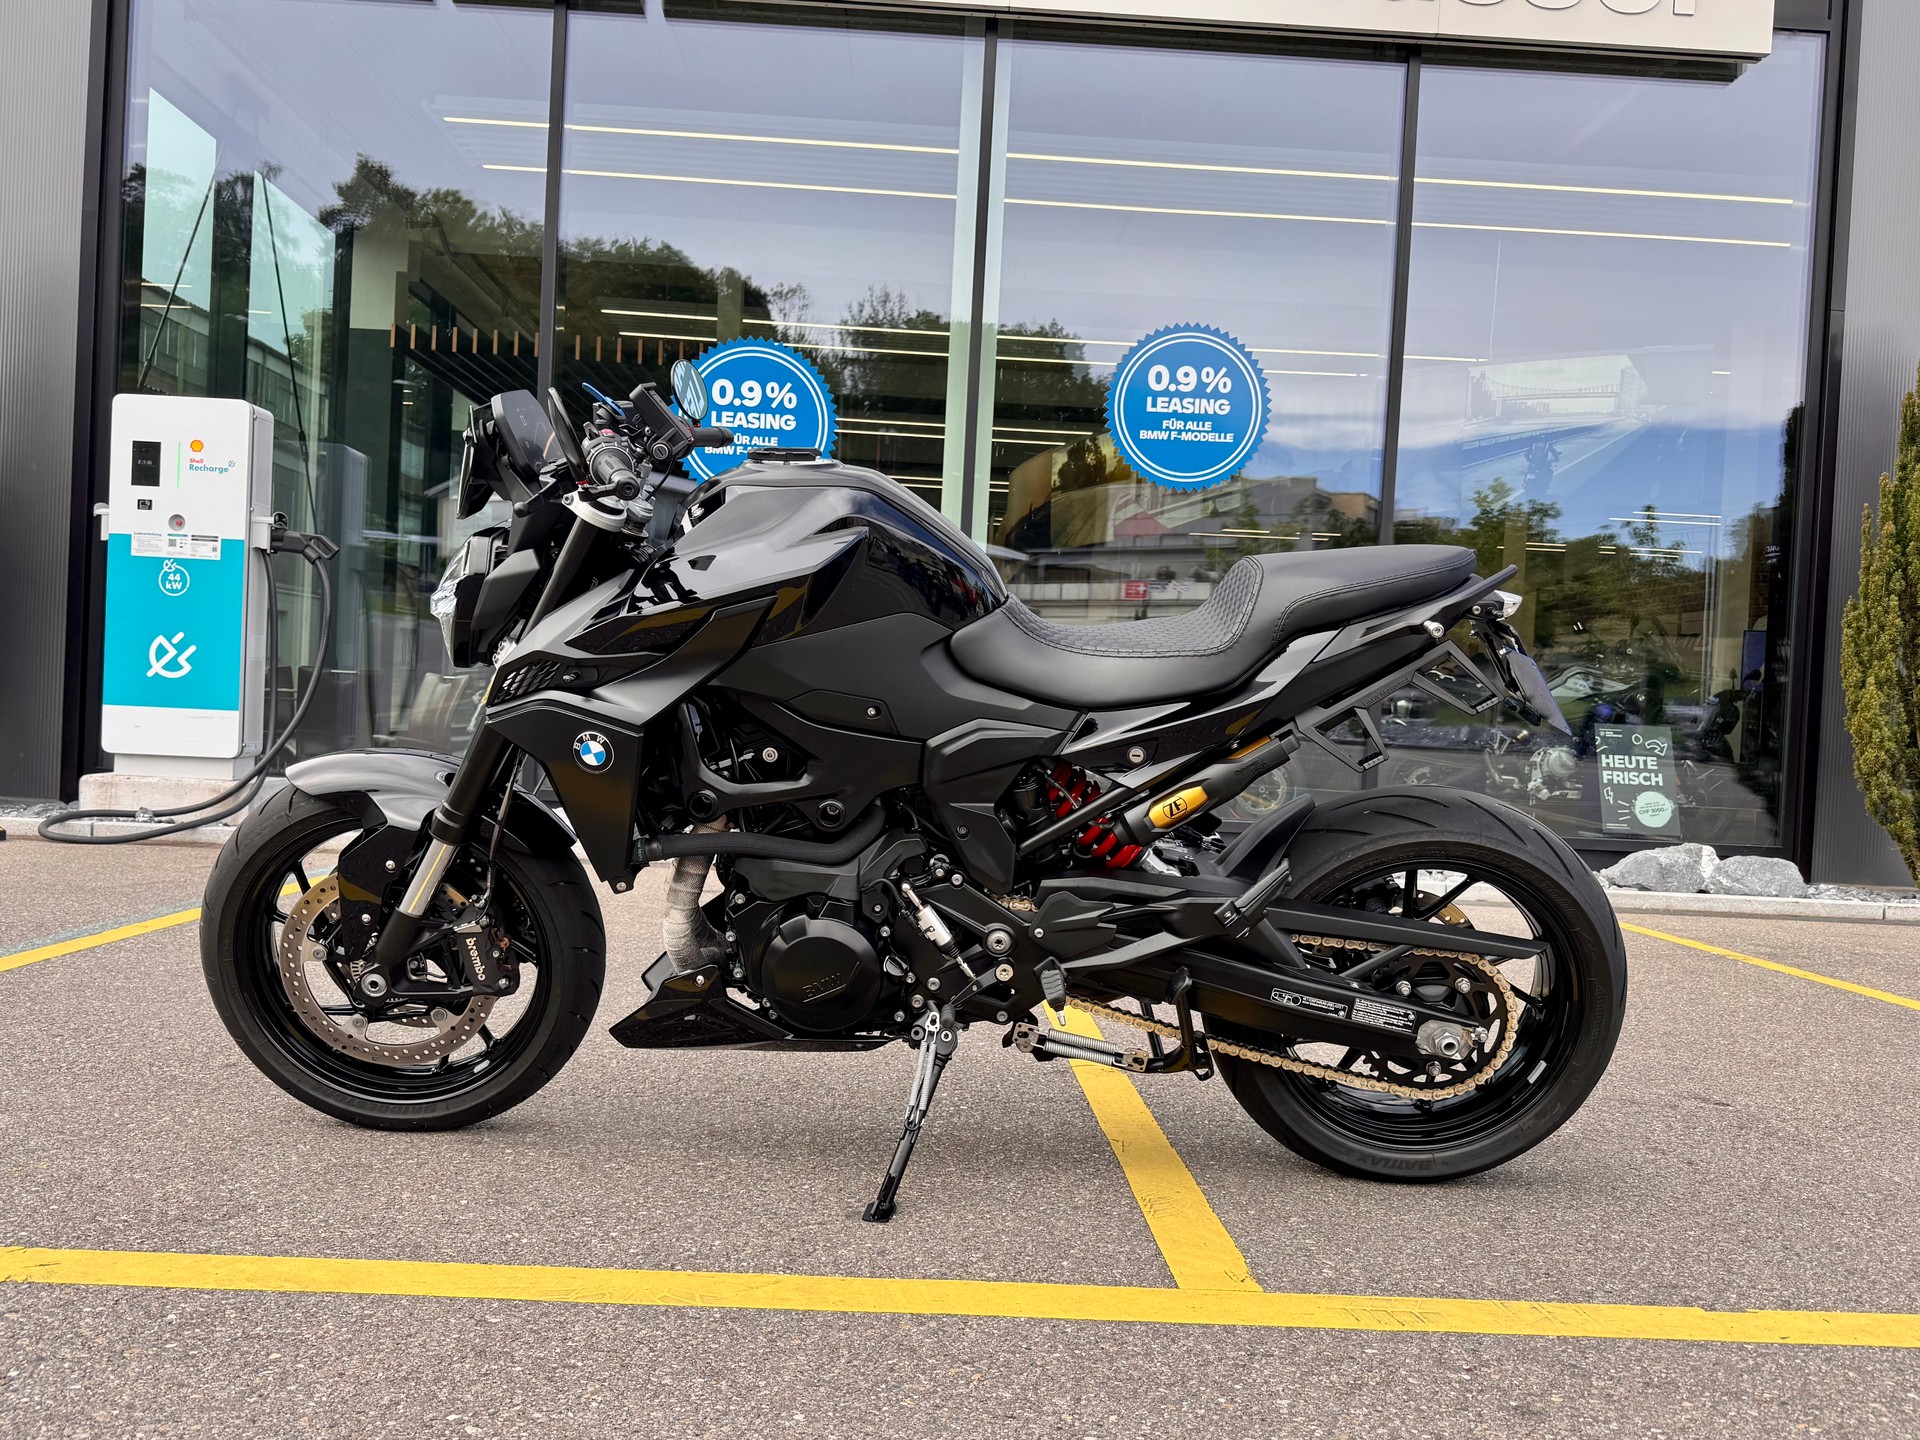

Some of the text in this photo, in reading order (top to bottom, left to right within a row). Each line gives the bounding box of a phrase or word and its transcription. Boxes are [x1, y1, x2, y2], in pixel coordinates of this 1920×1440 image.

[1146, 396, 1231, 415] LEASING
[711, 411, 797, 430] LEASING
[1162, 418, 1212, 431] FÜR ALLE
[733, 433, 778, 446] ÜR ALLE
[1139, 431, 1234, 443] BMW F-MODELLE
[705, 446, 735, 455] BMW
[189, 464, 229, 474] Recharge
[168, 573, 181, 581] 44
[166, 581, 183, 590] kW
[574, 734, 605, 750] BMW
[1601, 754, 1658, 770] HEUTE
[1602, 771, 1663, 786] FRISCH
[1167, 798, 1185, 818] ZF
[466, 937, 486, 981] brembo
[802, 973, 840, 997] BMW
